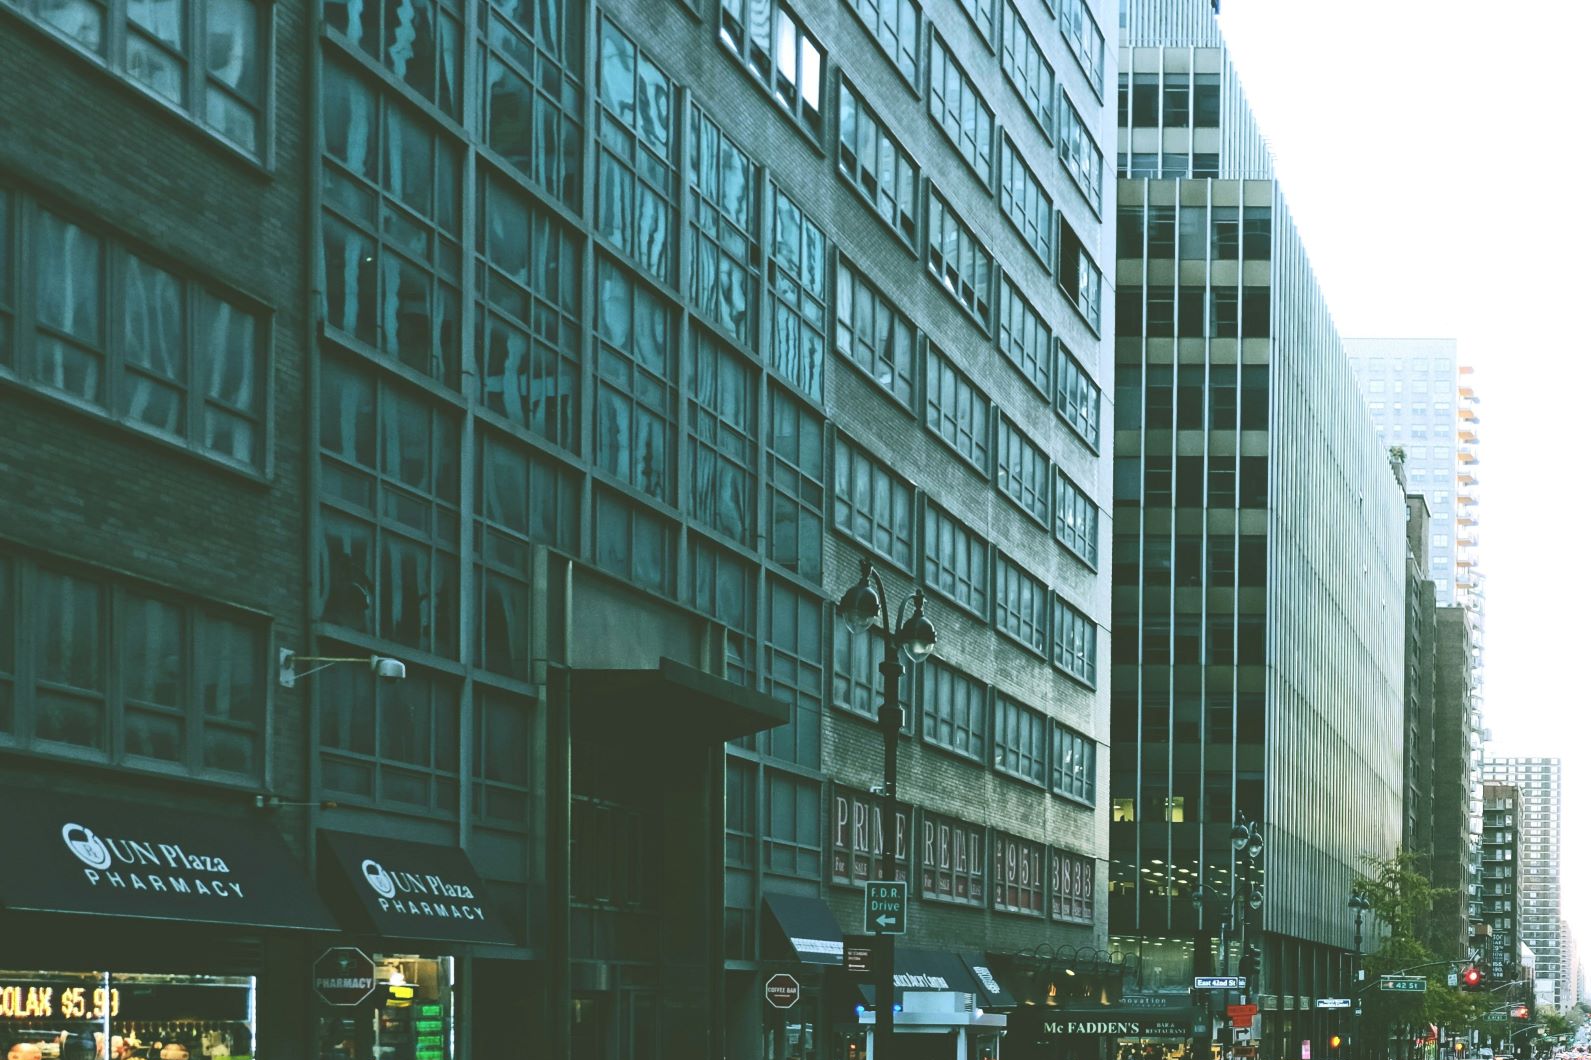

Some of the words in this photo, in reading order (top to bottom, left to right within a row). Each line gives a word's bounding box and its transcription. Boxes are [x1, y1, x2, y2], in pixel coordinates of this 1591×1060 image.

[106, 837, 160, 866] UN
[158, 843, 230, 873] Plaza
[924, 821, 981, 875] RETAIL
[835, 857, 845, 872] For
[854, 862, 867, 875] SALE
[1009, 844, 1040, 886] 951
[1053, 856, 1091, 897] 3833
[84, 868, 244, 898] PHARMACY
[391, 871, 428, 894] UN
[425, 875, 475, 899] Plaza
[871, 888, 900, 898] F.D.R.
[378, 897, 485, 920] PHARMACY
[871, 901, 900, 912] Drive
[316, 978, 372, 989] PHARMACY
[1228, 979, 1236, 987] St
[1044, 1022, 1063, 1034] Mc
[1068, 1022, 1140, 1034] FADDEN'S
